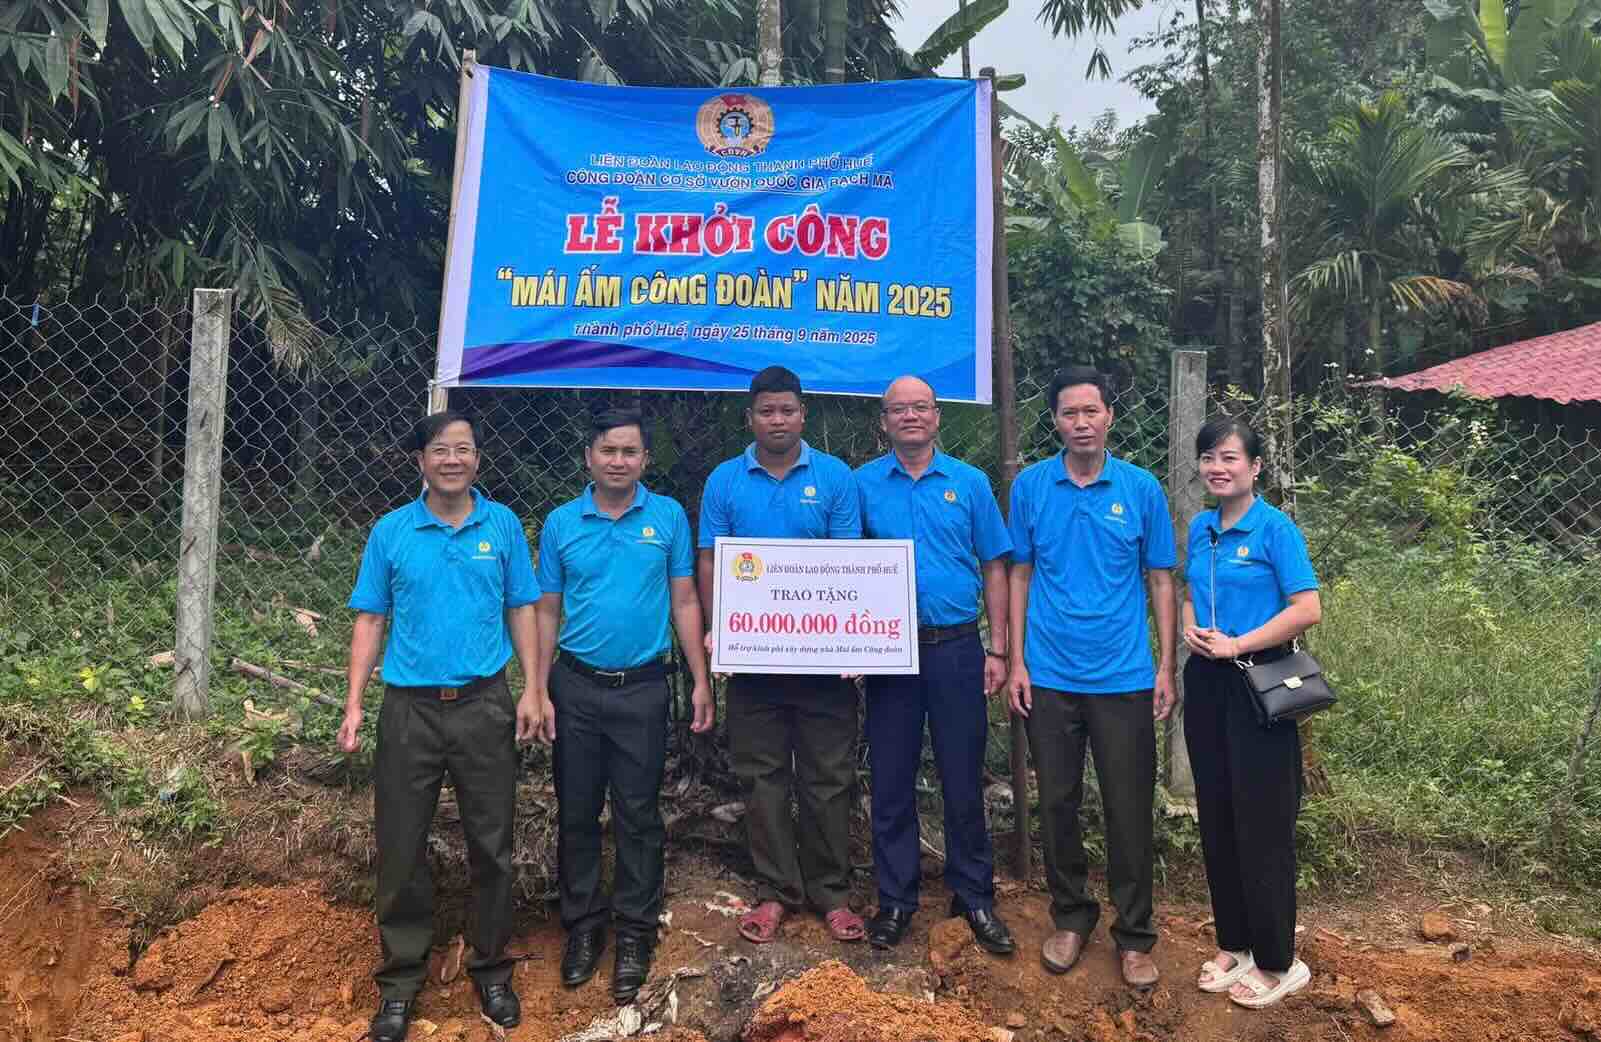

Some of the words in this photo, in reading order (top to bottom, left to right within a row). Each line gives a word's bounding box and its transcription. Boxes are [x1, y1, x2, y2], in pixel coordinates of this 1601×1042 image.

[567, 168, 609, 185] CÔNG
[614, 170, 655, 186] ĐOÀN
[800, 176, 826, 190] GIA
[563, 197, 624, 254] LỄ
[634, 202, 754, 256] KHỞI
[764, 204, 890, 260] CÔNG
[497, 267, 567, 307] “MÁI
[575, 265, 620, 308] ẤM
[630, 269, 707, 307] CÔNG
[715, 268, 808, 309] ĐOÀN”
[816, 273, 880, 313] NĂM
[887, 286, 952, 318] 2025
[624, 320, 655, 338] phố
[692, 325, 729, 341] ngày
[733, 326, 749, 338] 25
[752, 326, 793, 343] tháng
[798, 329, 806, 341] 9
[810, 329, 840, 342] năm
[844, 331, 876, 345] 2025
[770, 589, 812, 601] TRAO
[816, 587, 859, 604] TẶNG
[729, 611, 837, 634] 60.000.000
[845, 609, 901, 640] đồng
